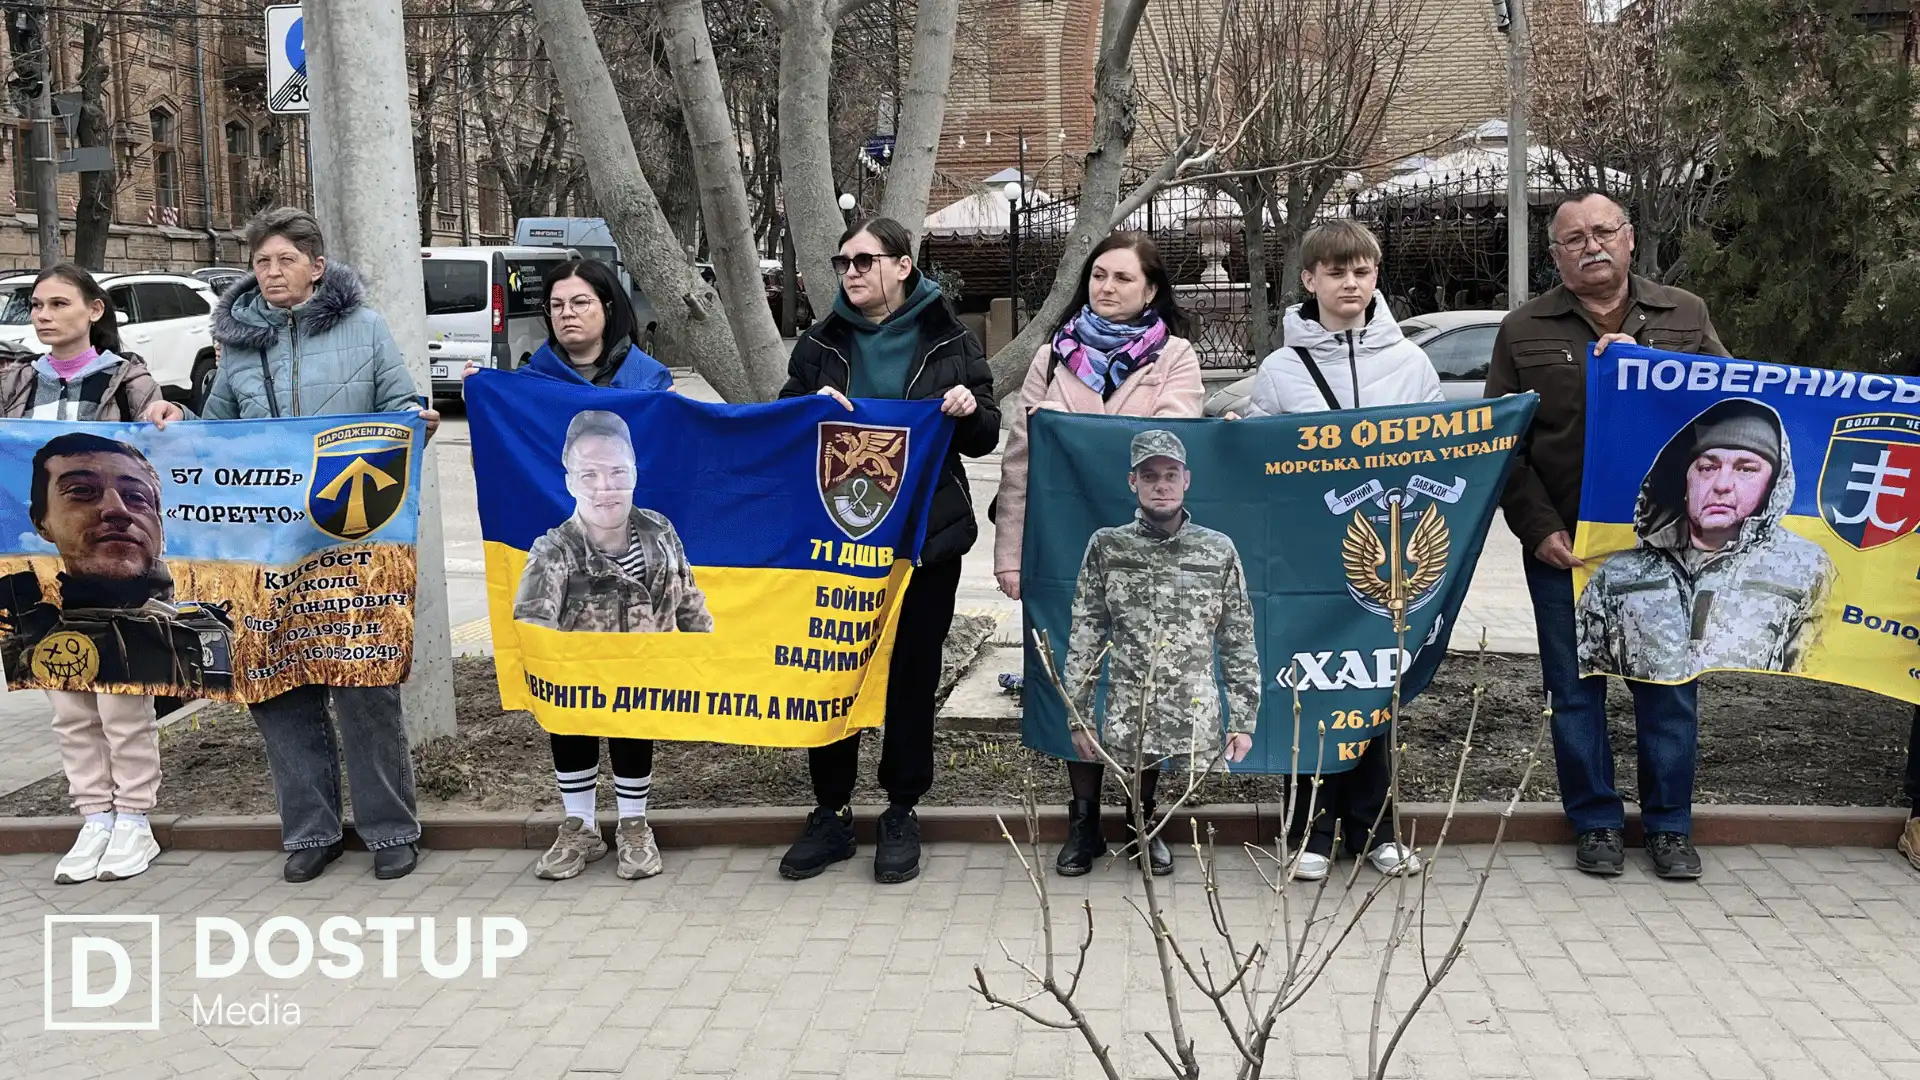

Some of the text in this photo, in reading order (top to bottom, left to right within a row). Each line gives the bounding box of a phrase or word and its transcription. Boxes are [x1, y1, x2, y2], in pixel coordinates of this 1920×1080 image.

[1618, 358, 1920, 404] ПОВЕРНИСЬ
[1297, 406, 1494, 450] 38 ОБРМП
[1845, 417, 1880, 428] ВОЛЯ
[318, 427, 409, 446] НАРОДЖЕНІ В БОЯХ
[171, 468, 203, 485] 57
[1265, 457, 1361, 475] МОРСЬКА
[1343, 483, 1374, 507] ВІРНИЙ
[1412, 477, 1448, 498] ЗАВЖДИ
[166, 504, 306, 523] «ТОРЕТТО»
[810, 539, 894, 568] 71 ДШВ
[816, 585, 886, 612] БОЙКО
[1841, 604, 1920, 645] Воло
[523, 668, 858, 723] ВЕРНІТЬ ДИТИНІ ТАТА, А МАТЕР
